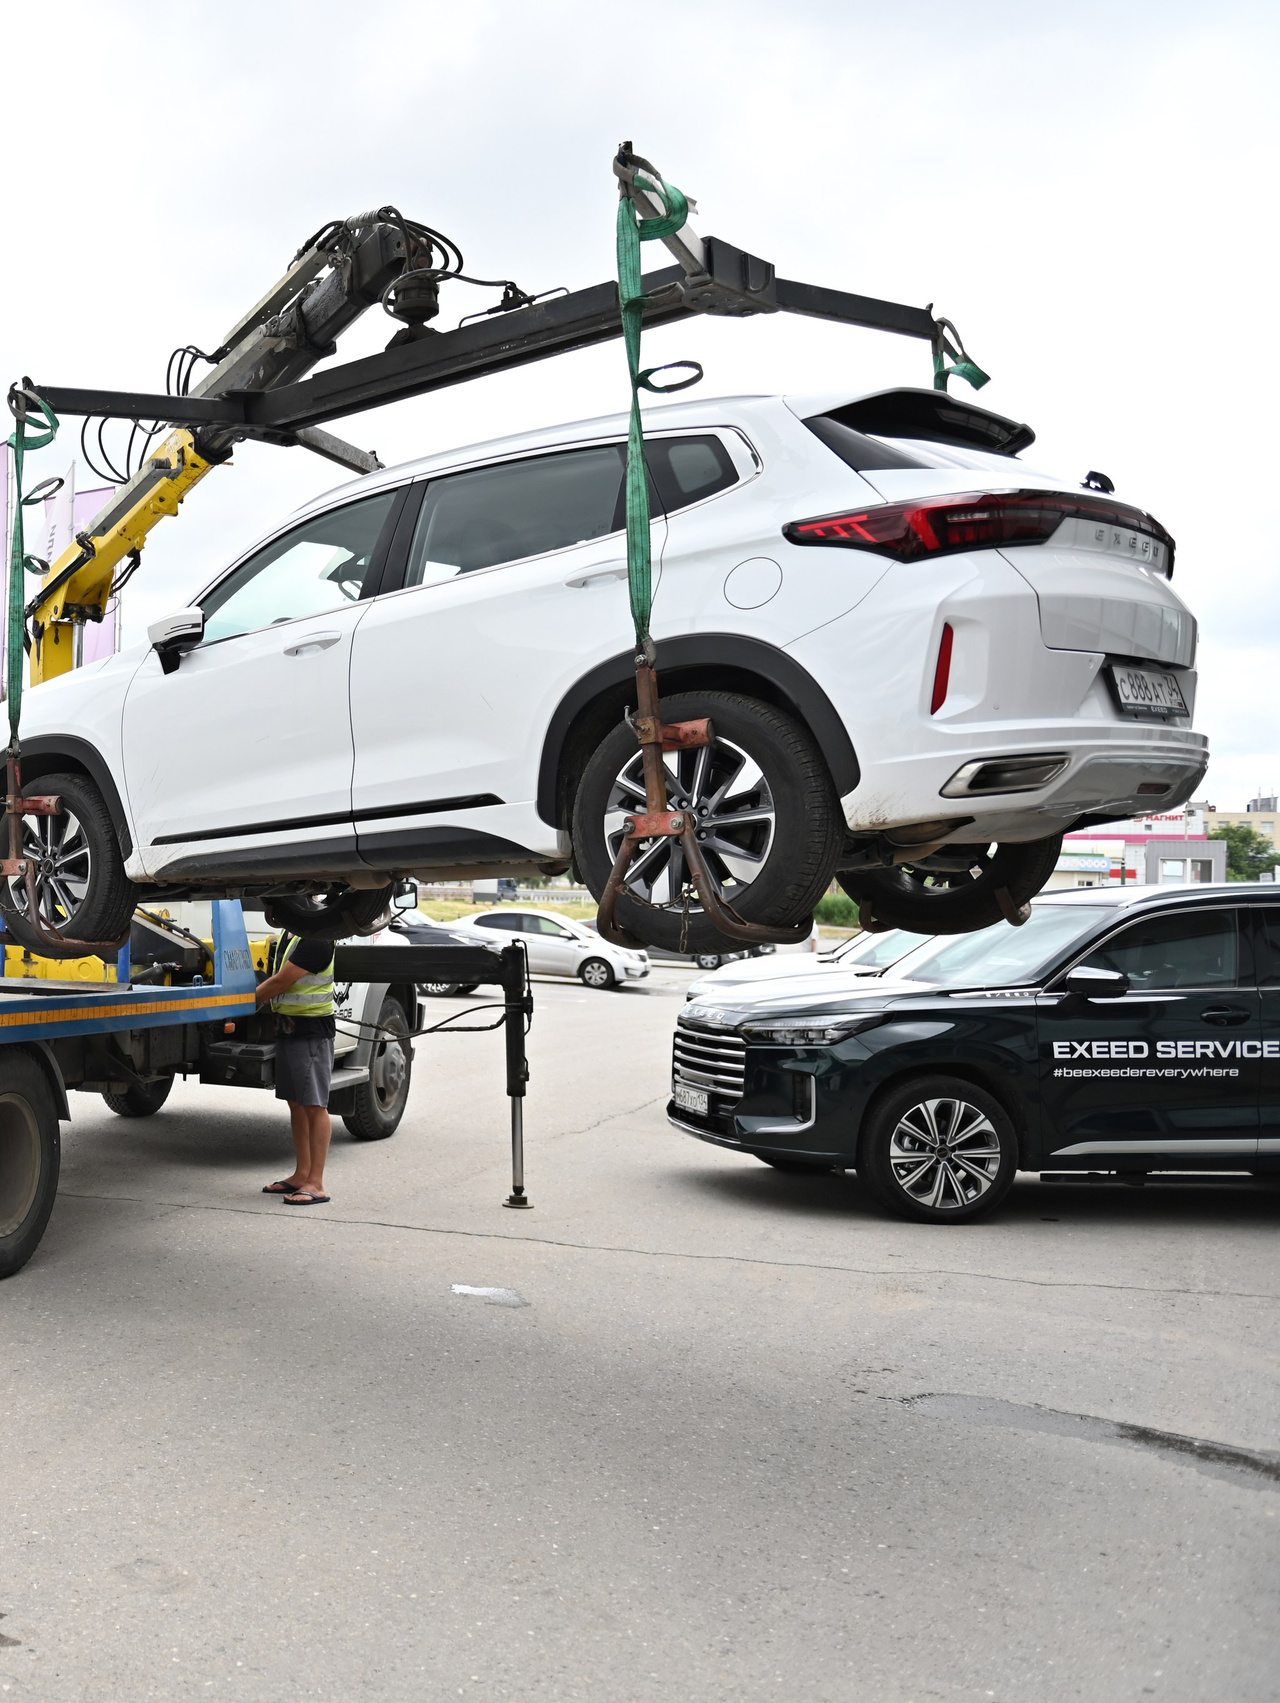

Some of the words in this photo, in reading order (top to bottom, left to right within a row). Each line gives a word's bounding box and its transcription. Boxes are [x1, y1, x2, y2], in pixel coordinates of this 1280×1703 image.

[1094, 528, 1159, 557] EXEED
[1146, 814, 1184, 822] МАГНИТ
[1053, 1041, 1149, 1058] EXEED
[1156, 1041, 1280, 1058] SERVICE
[1053, 1067, 1239, 1078] #beexeedereverywhere
